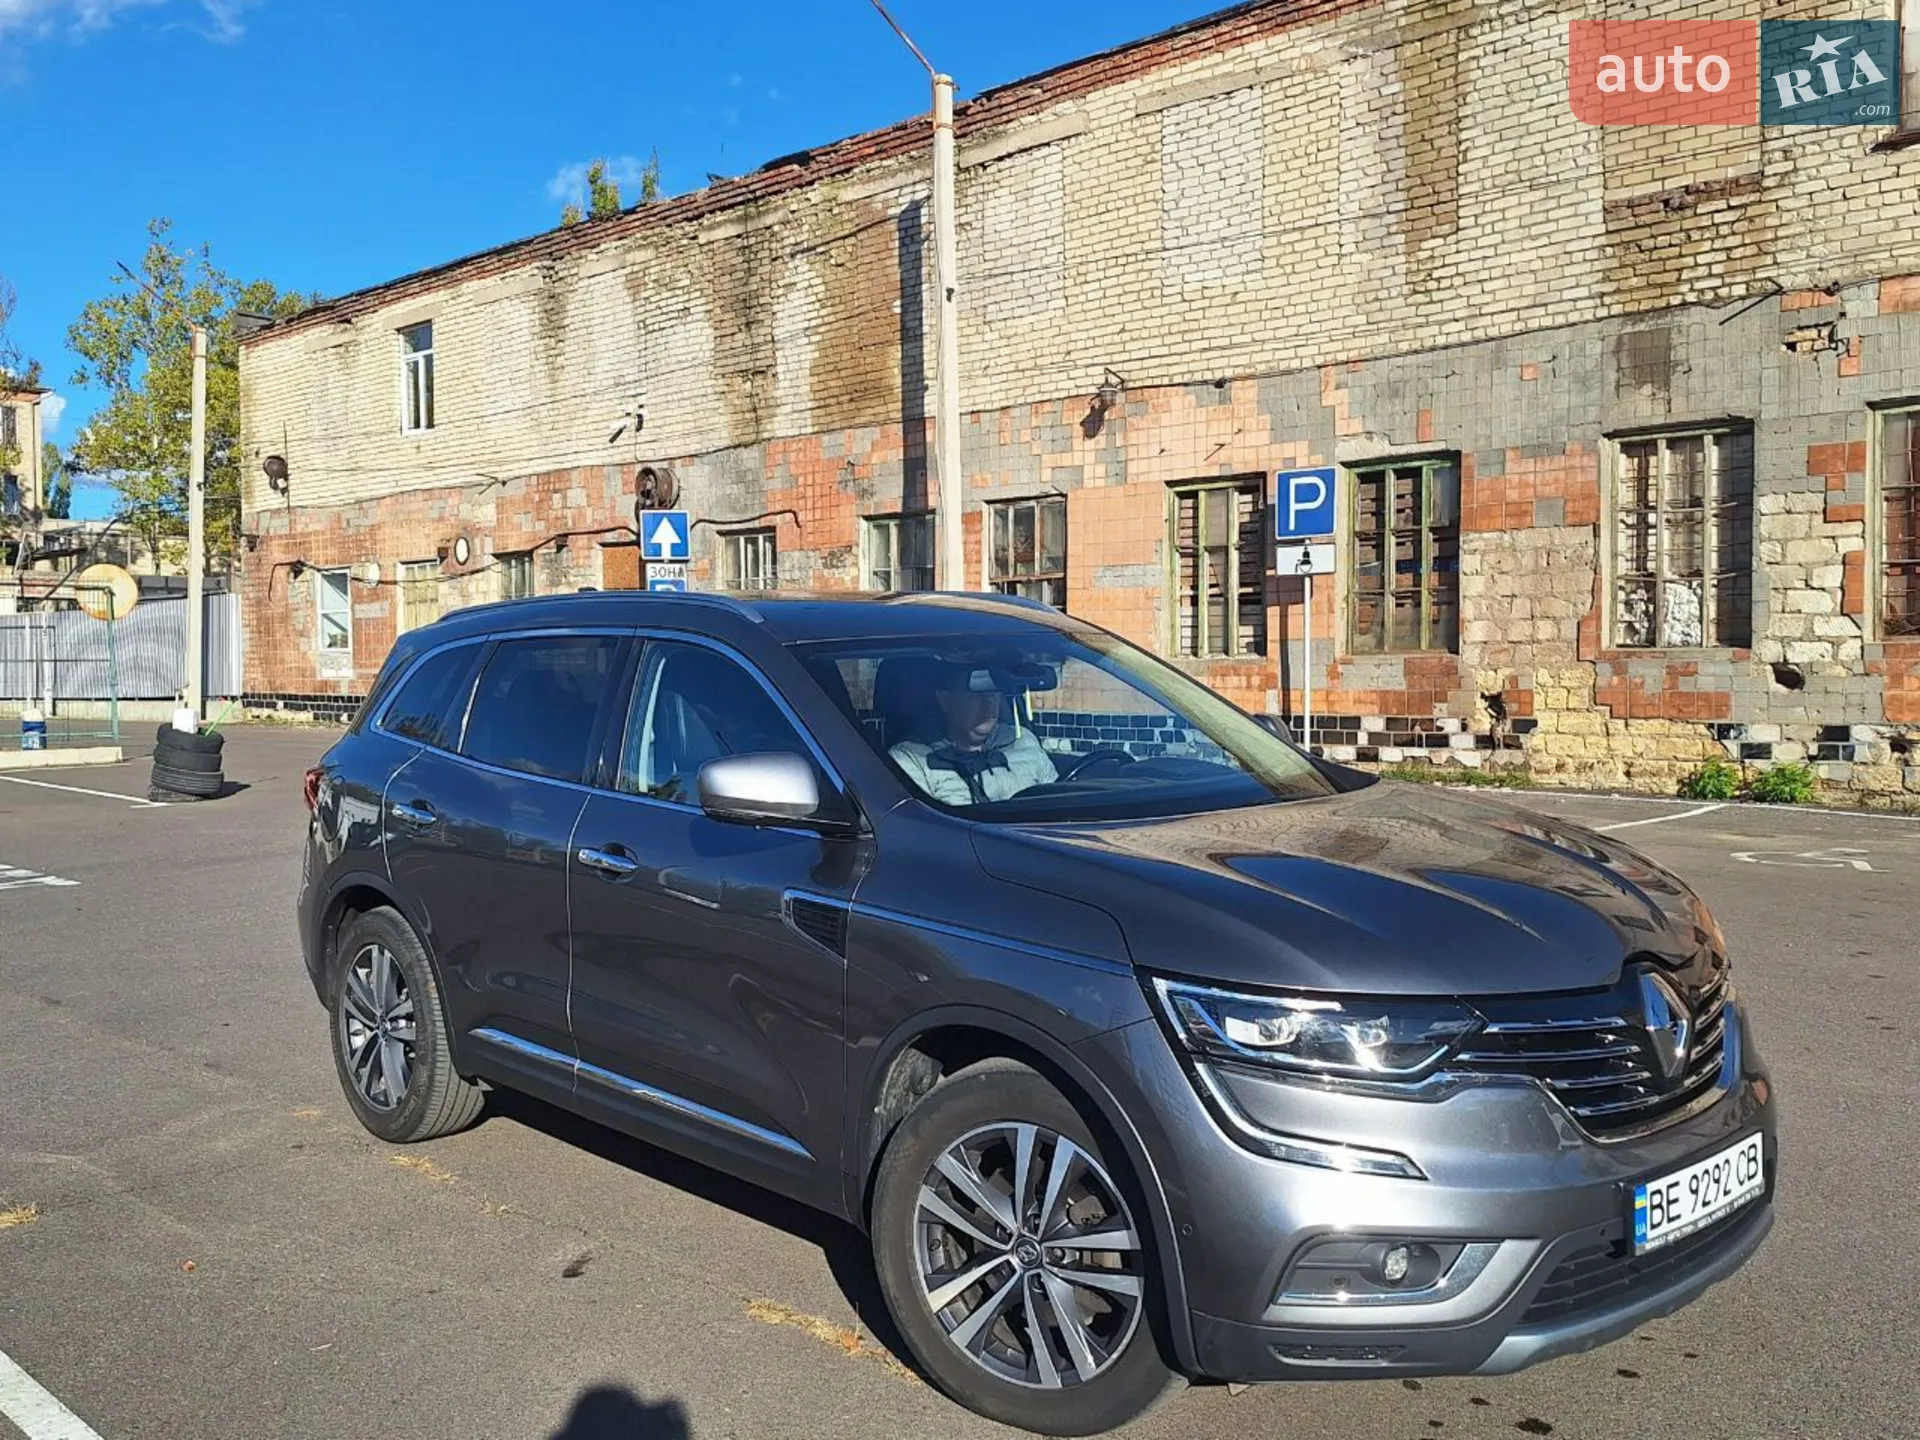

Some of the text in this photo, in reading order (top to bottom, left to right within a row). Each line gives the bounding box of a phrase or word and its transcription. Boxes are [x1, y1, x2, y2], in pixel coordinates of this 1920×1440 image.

[1288, 476, 1327, 531] P
[650, 566, 685, 578] ЗОНА
[1650, 1181, 1682, 1230] BE
[1688, 1158, 1731, 1214] 9292
[1736, 1143, 1759, 1186] CB
[1635, 1223, 1647, 1237] UA
